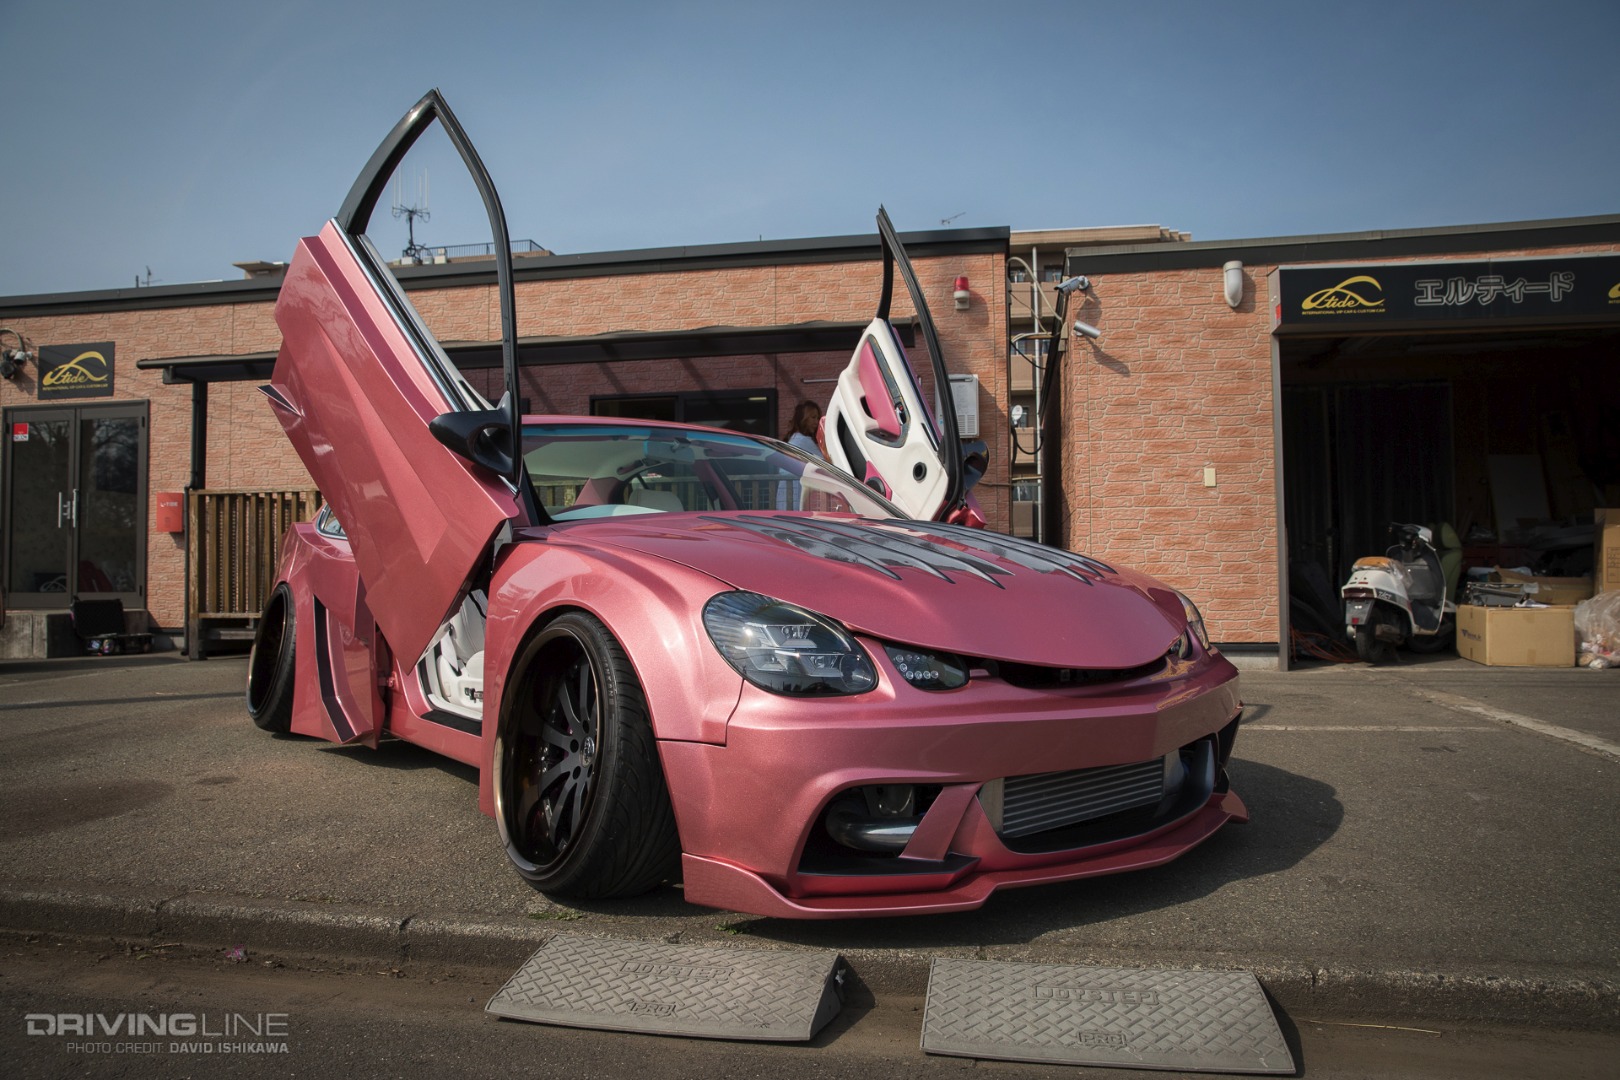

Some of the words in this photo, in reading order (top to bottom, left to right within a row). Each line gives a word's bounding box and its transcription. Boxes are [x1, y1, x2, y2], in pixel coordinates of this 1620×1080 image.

[1414, 272, 1576, 307] エルティード
